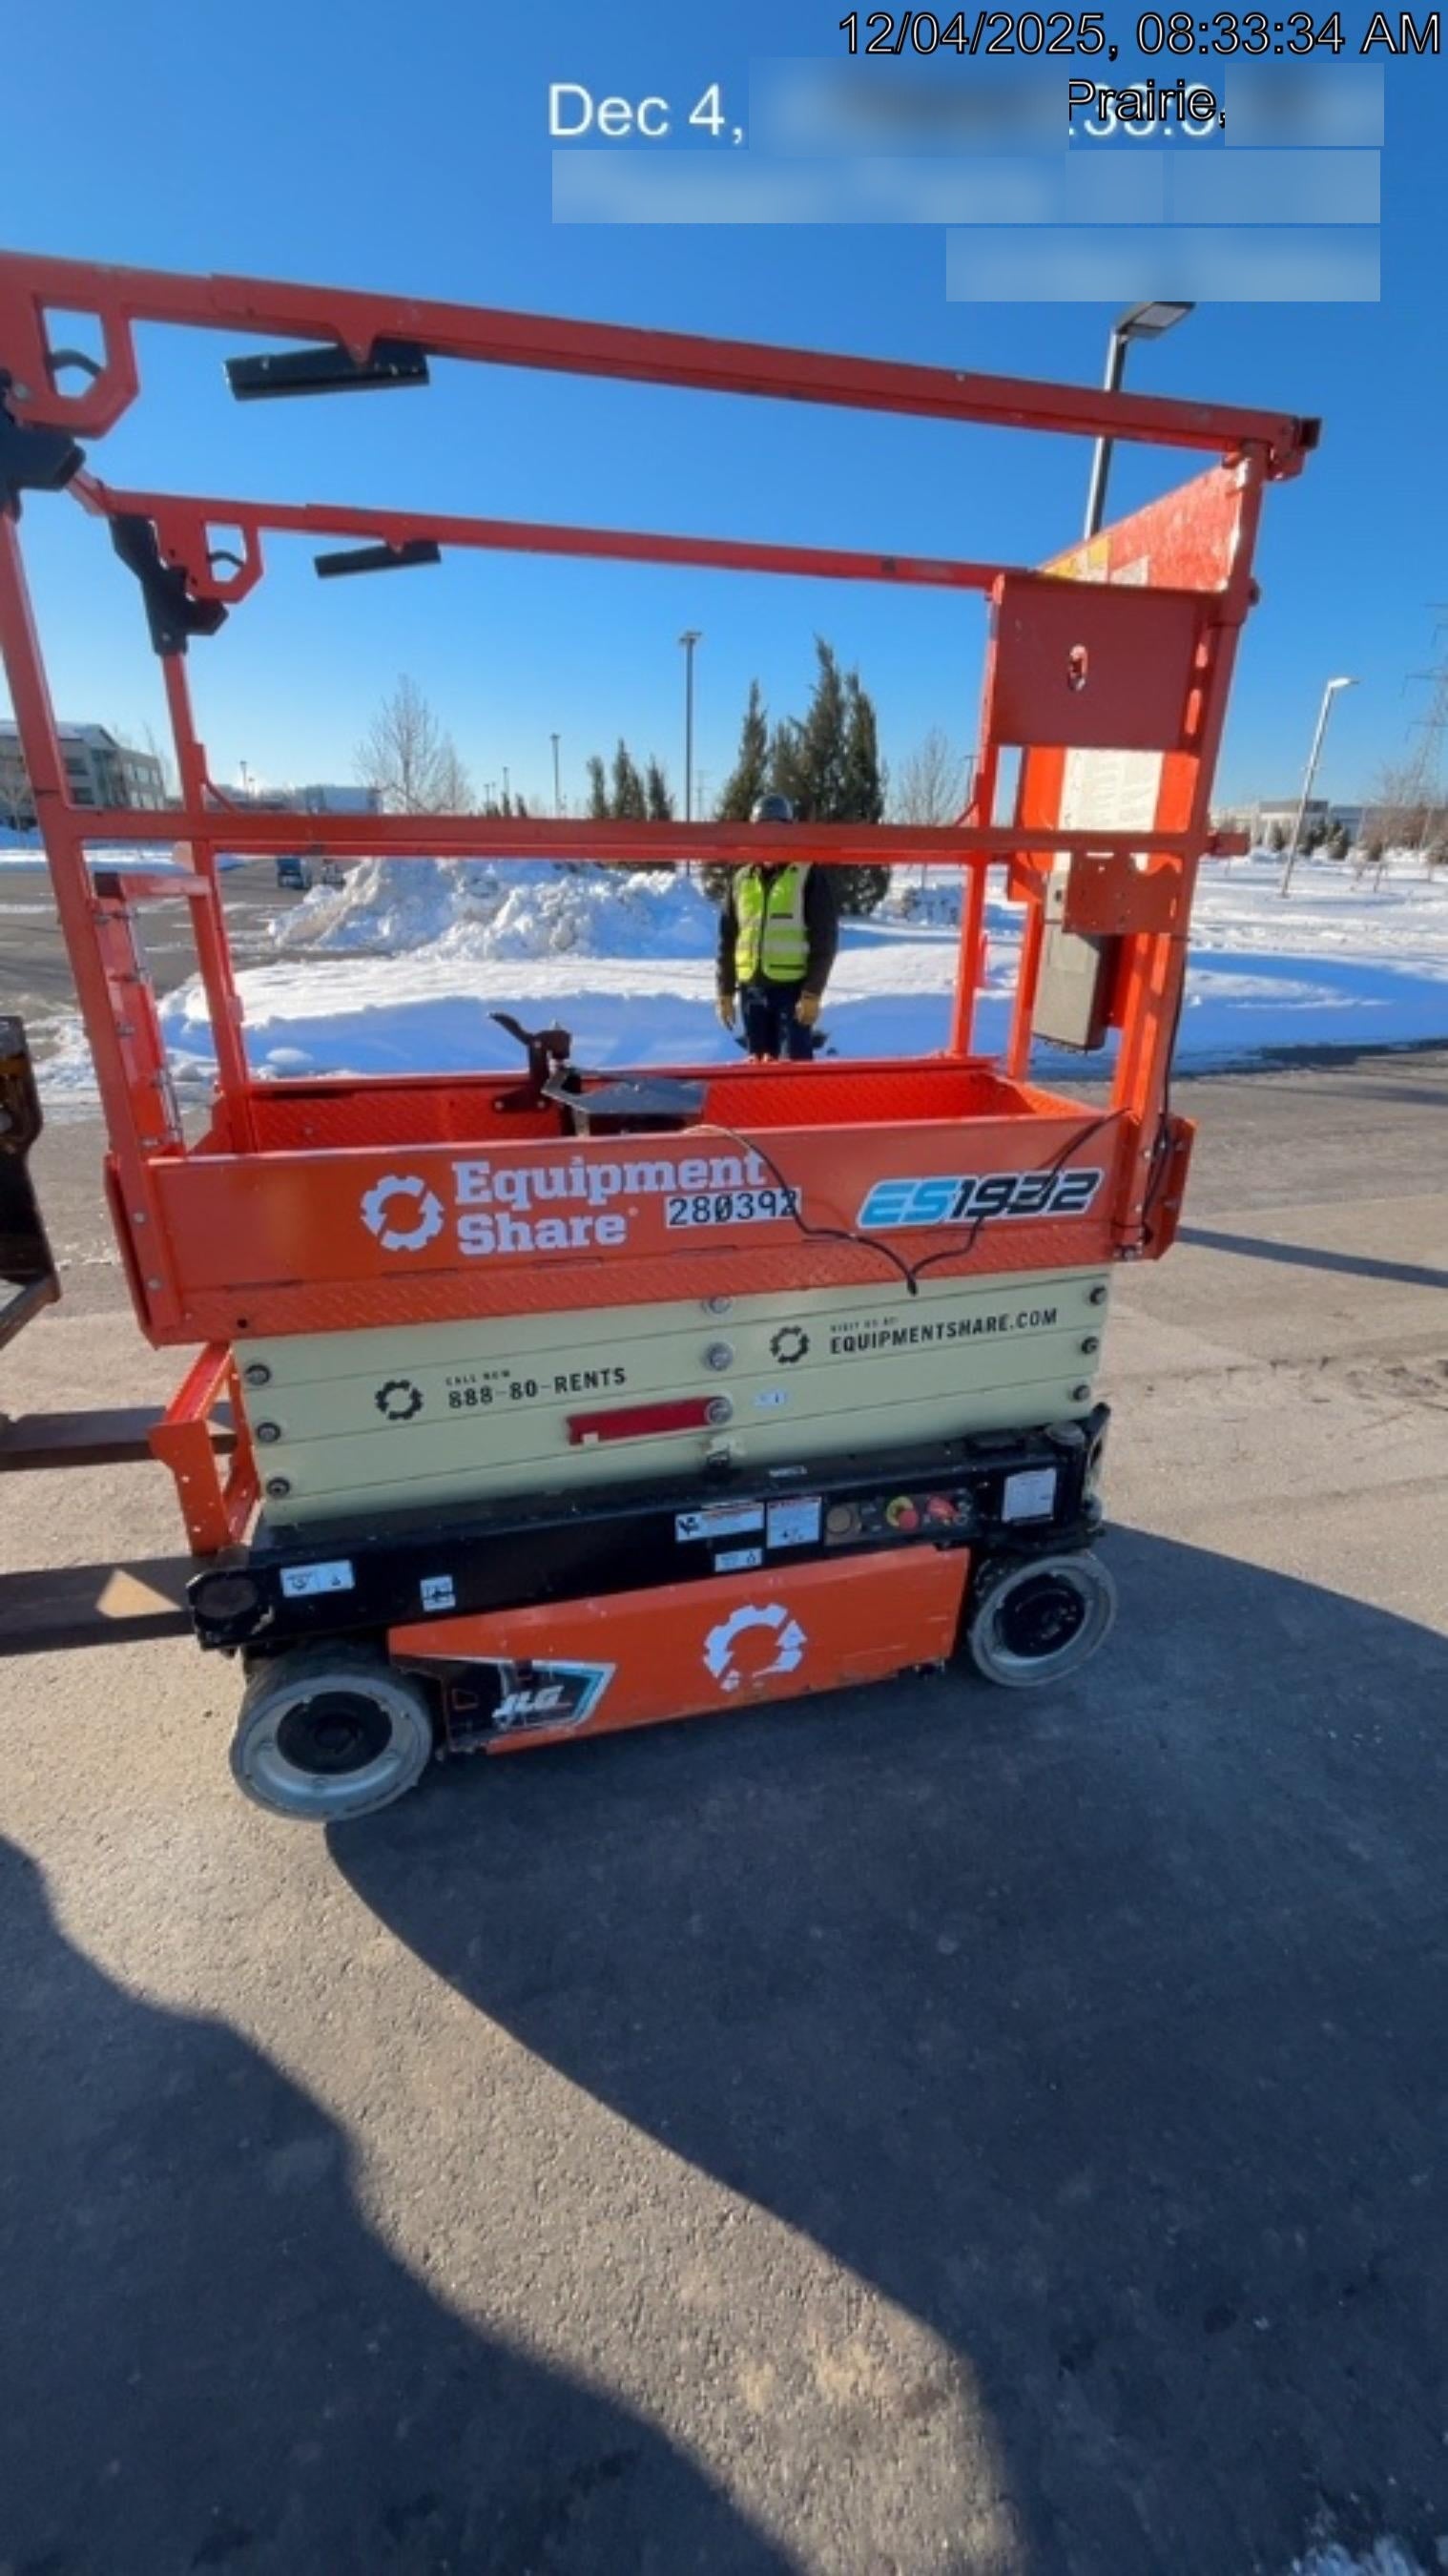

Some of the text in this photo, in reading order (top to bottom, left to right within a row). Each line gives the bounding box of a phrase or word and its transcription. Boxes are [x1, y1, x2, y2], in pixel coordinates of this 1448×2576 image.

[451, 1150, 768, 1212] Equipment
[858, 1169, 1103, 1228] ES1932
[667, 1189, 798, 1227] 280392
[456, 1213, 628, 1256] Share
[829, 1307, 1059, 1355] EQUIPMENTSHARE.COM
[447, 1366, 627, 1409] 888-80-RENTS
